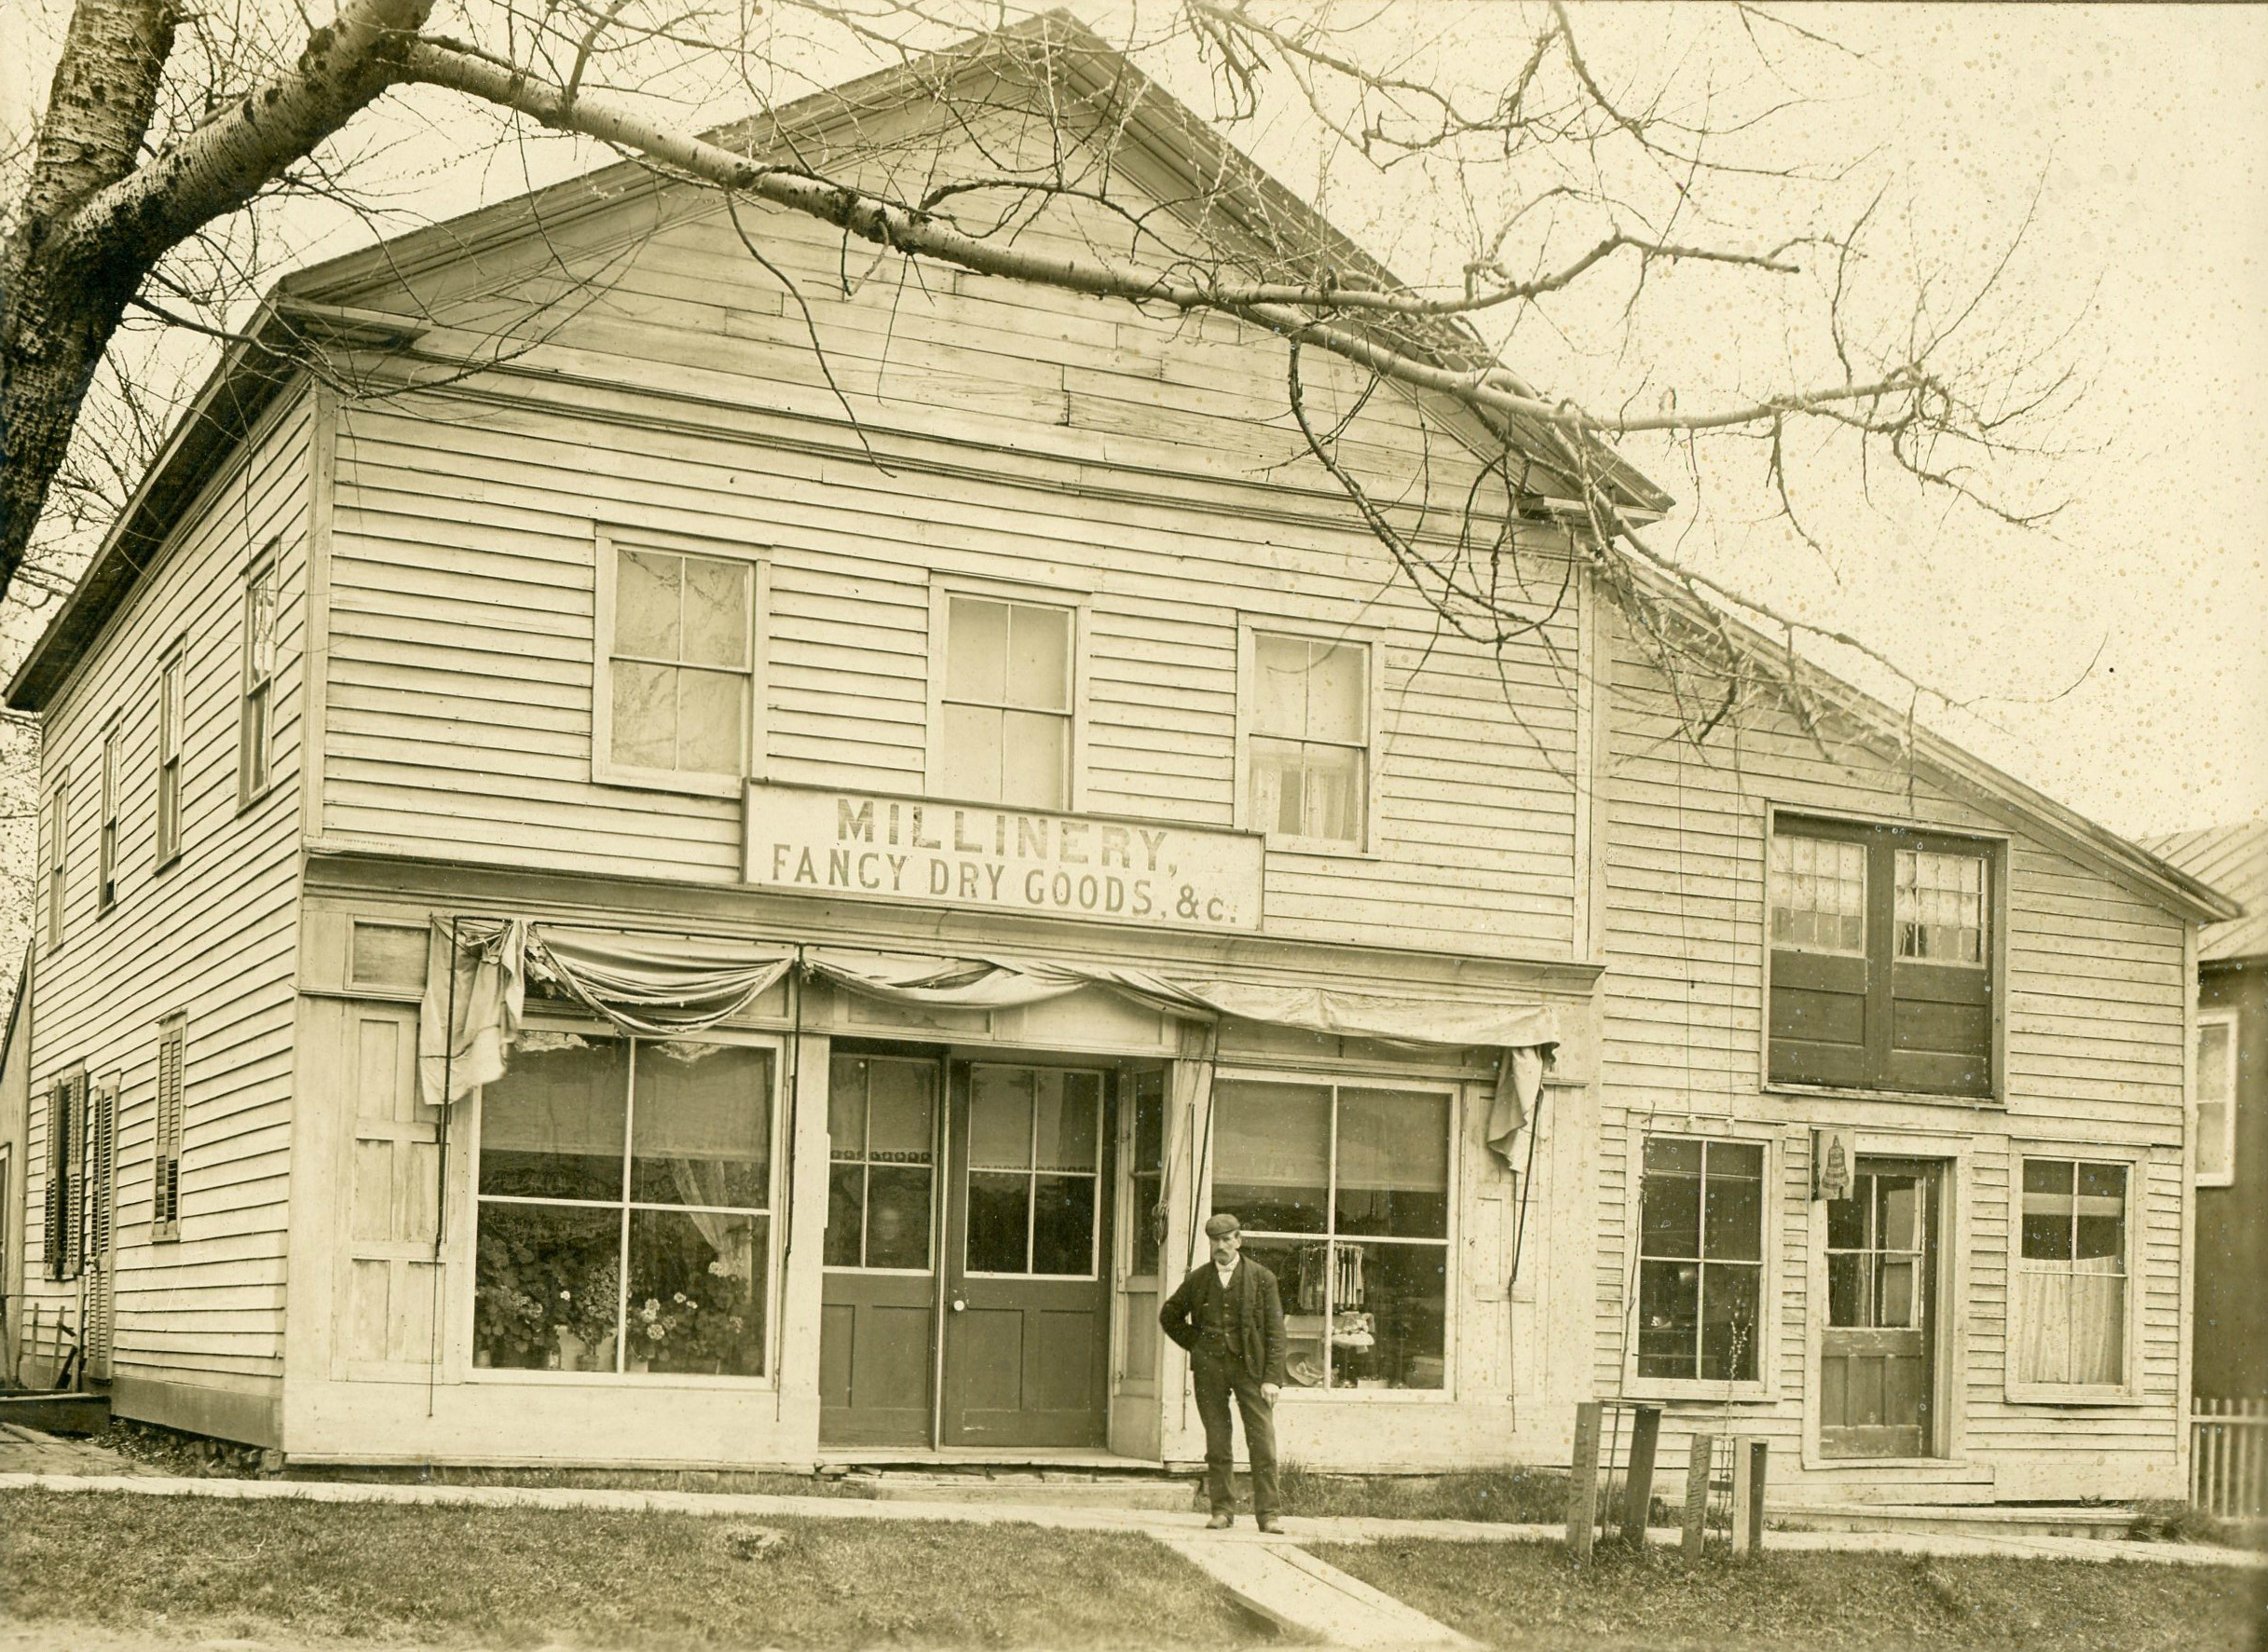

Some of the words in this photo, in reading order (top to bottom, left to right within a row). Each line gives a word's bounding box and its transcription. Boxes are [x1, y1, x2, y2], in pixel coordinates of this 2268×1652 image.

[838, 799, 1177, 877] MILLINERY,
[772, 843, 908, 891] FANCY
[930, 858, 1005, 900] DRY
[1025, 869, 1167, 918] GOODS,
